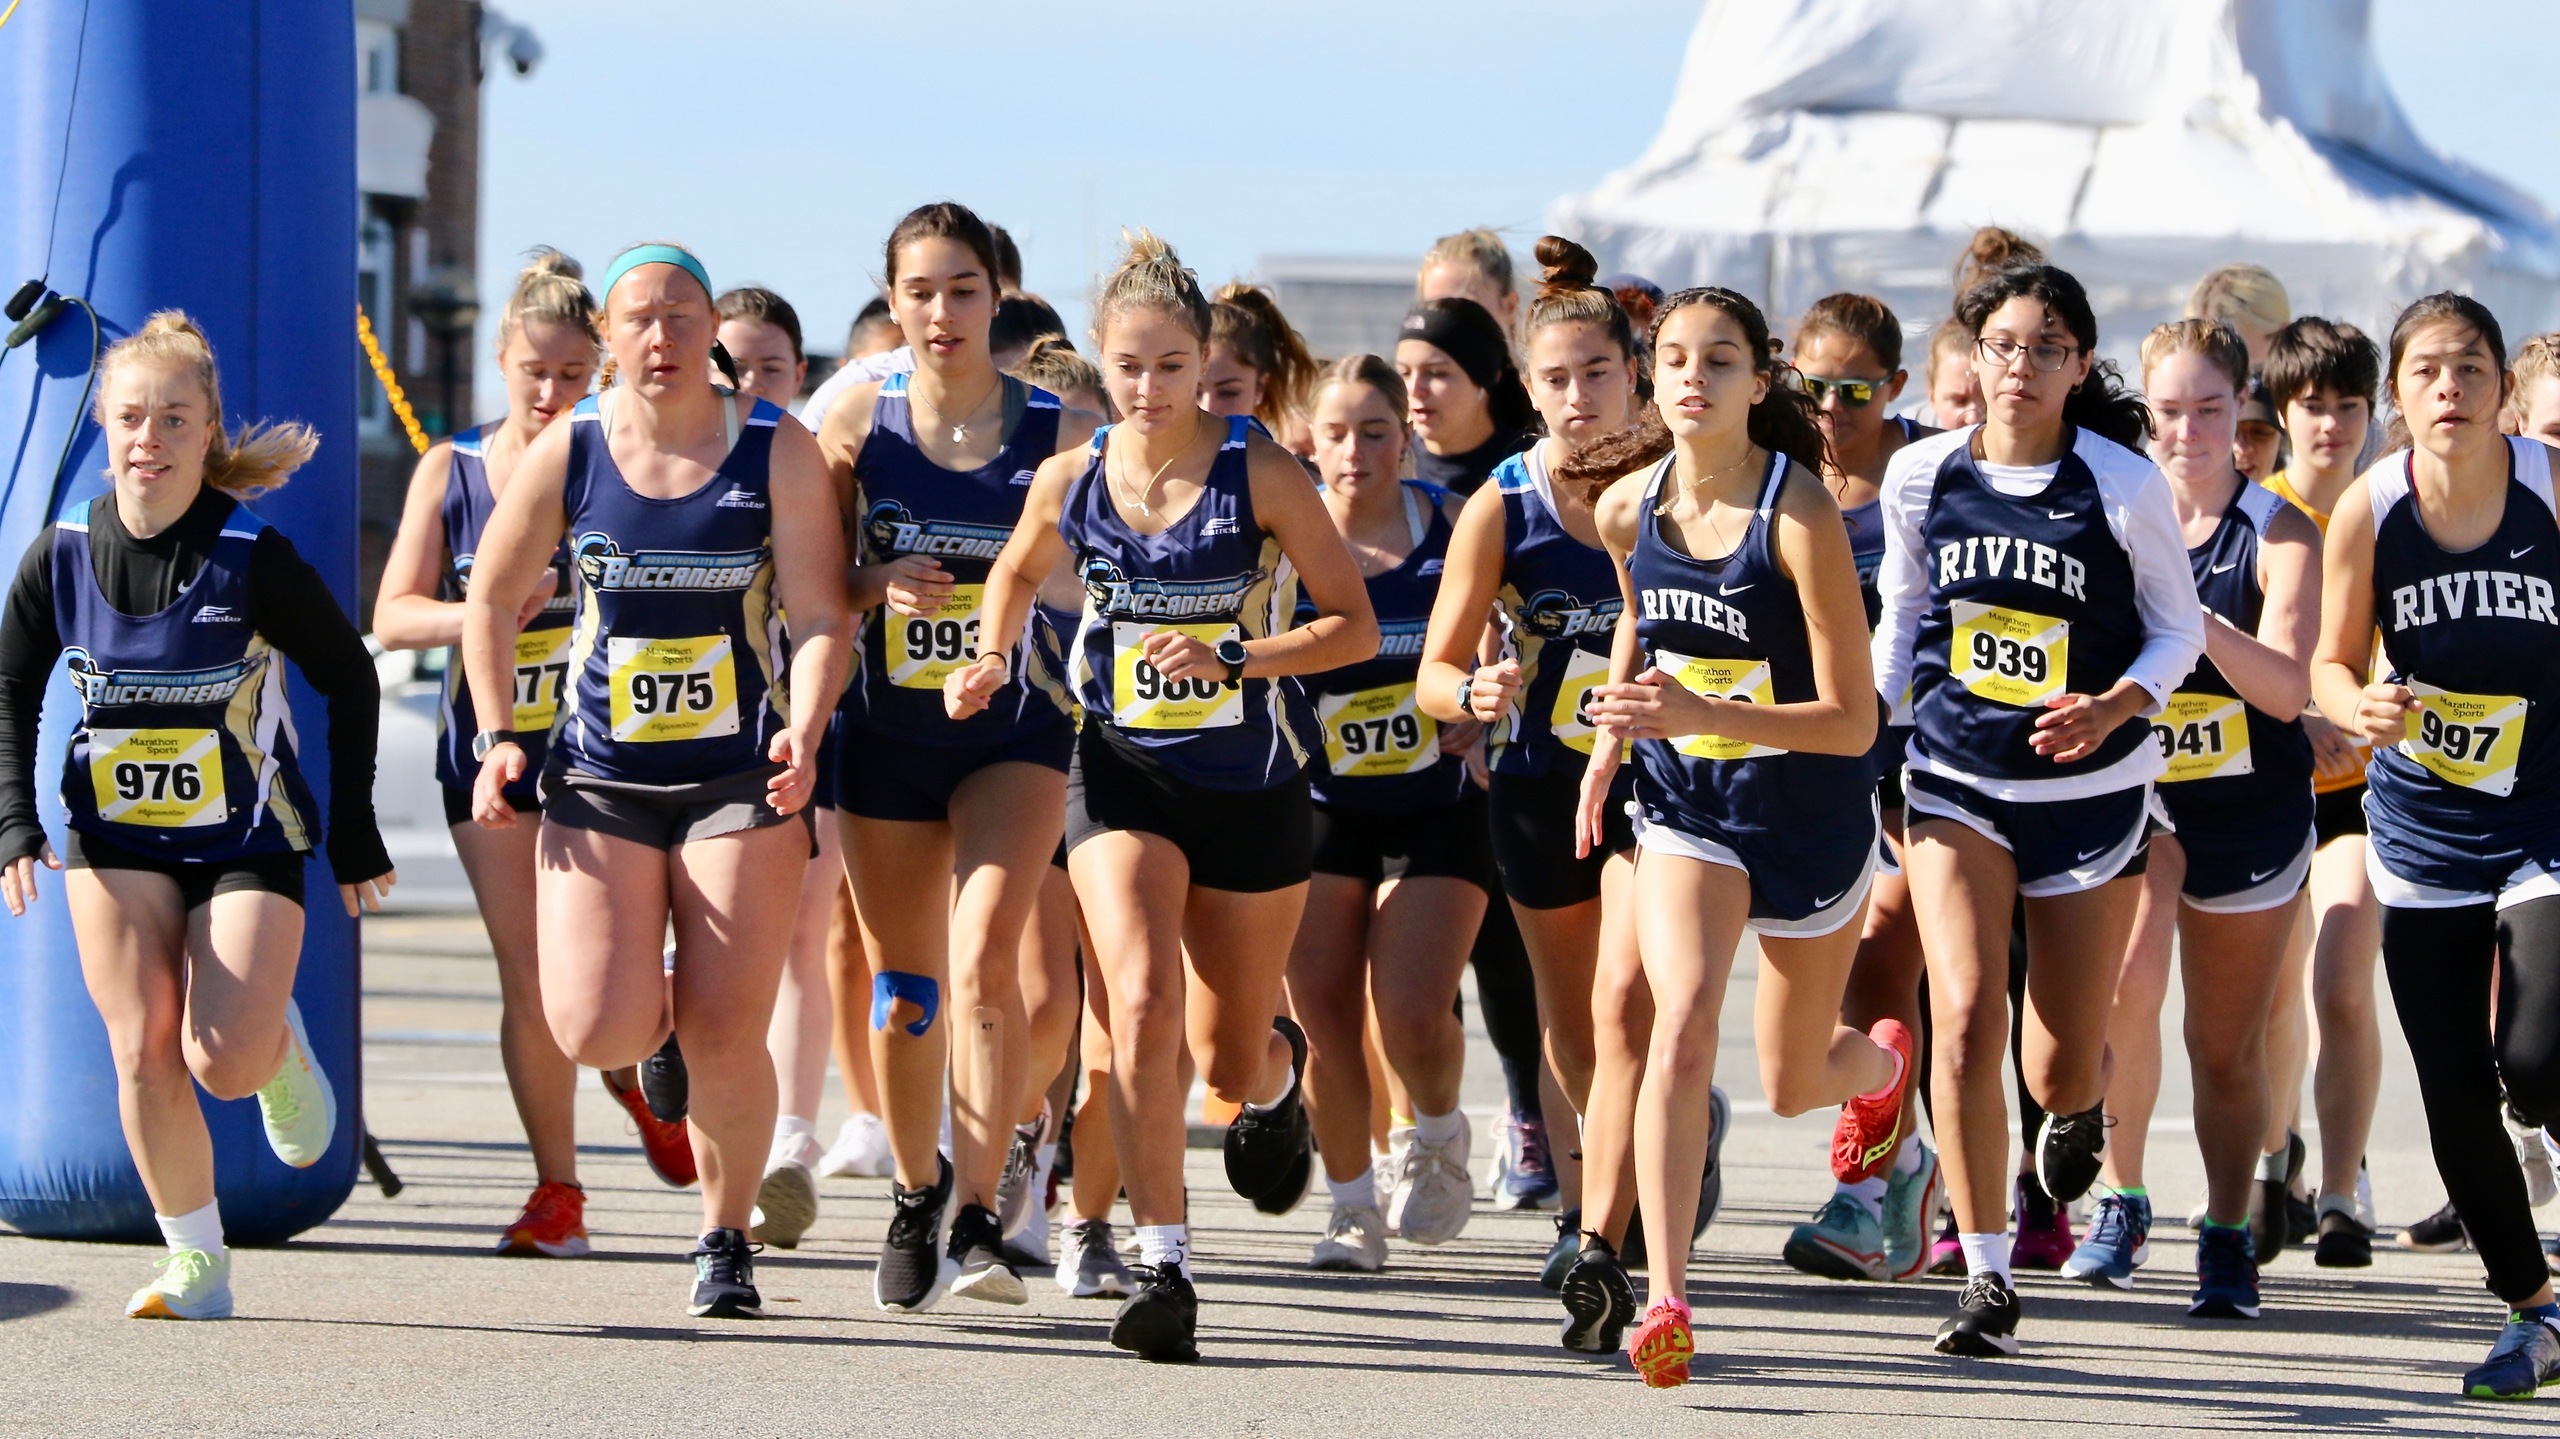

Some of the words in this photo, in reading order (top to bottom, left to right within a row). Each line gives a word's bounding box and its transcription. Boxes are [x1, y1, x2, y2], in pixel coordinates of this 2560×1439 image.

[891, 522, 1007, 559] BUCCANE
[597, 556, 760, 588] BUCCANEERS
[1939, 536, 2086, 602] RIVIER
[2393, 571, 2559, 632] RIVIER
[1642, 588, 1750, 642] RIVIER
[1988, 612, 2031, 629] Marathon
[907, 620, 980, 661] 993
[2003, 622, 2031, 636] Sports
[646, 647, 692, 656] Marathon
[662, 656, 693, 666] Sports
[1973, 631, 2047, 682] 939
[1688, 665, 1732, 676] Marathon
[1703, 676, 1733, 685] Sports
[80, 672, 243, 704] BUCCANEERS
[513, 662, 568, 704] 77
[632, 672, 713, 714] 975
[1350, 695, 1394, 708] Marathon
[1366, 702, 1396, 713] Sports
[2178, 708, 2208, 716] Sports
[2440, 695, 2486, 710] Marathon
[2453, 709, 2485, 719] Sports
[129, 738, 178, 747] Marathon
[1340, 714, 1419, 755] 979
[2152, 721, 2222, 759] 941
[2421, 710, 2500, 763] 997
[146, 746, 179, 756] Sports
[115, 763, 201, 801] 976
[982, 1022, 994, 1031] KT
